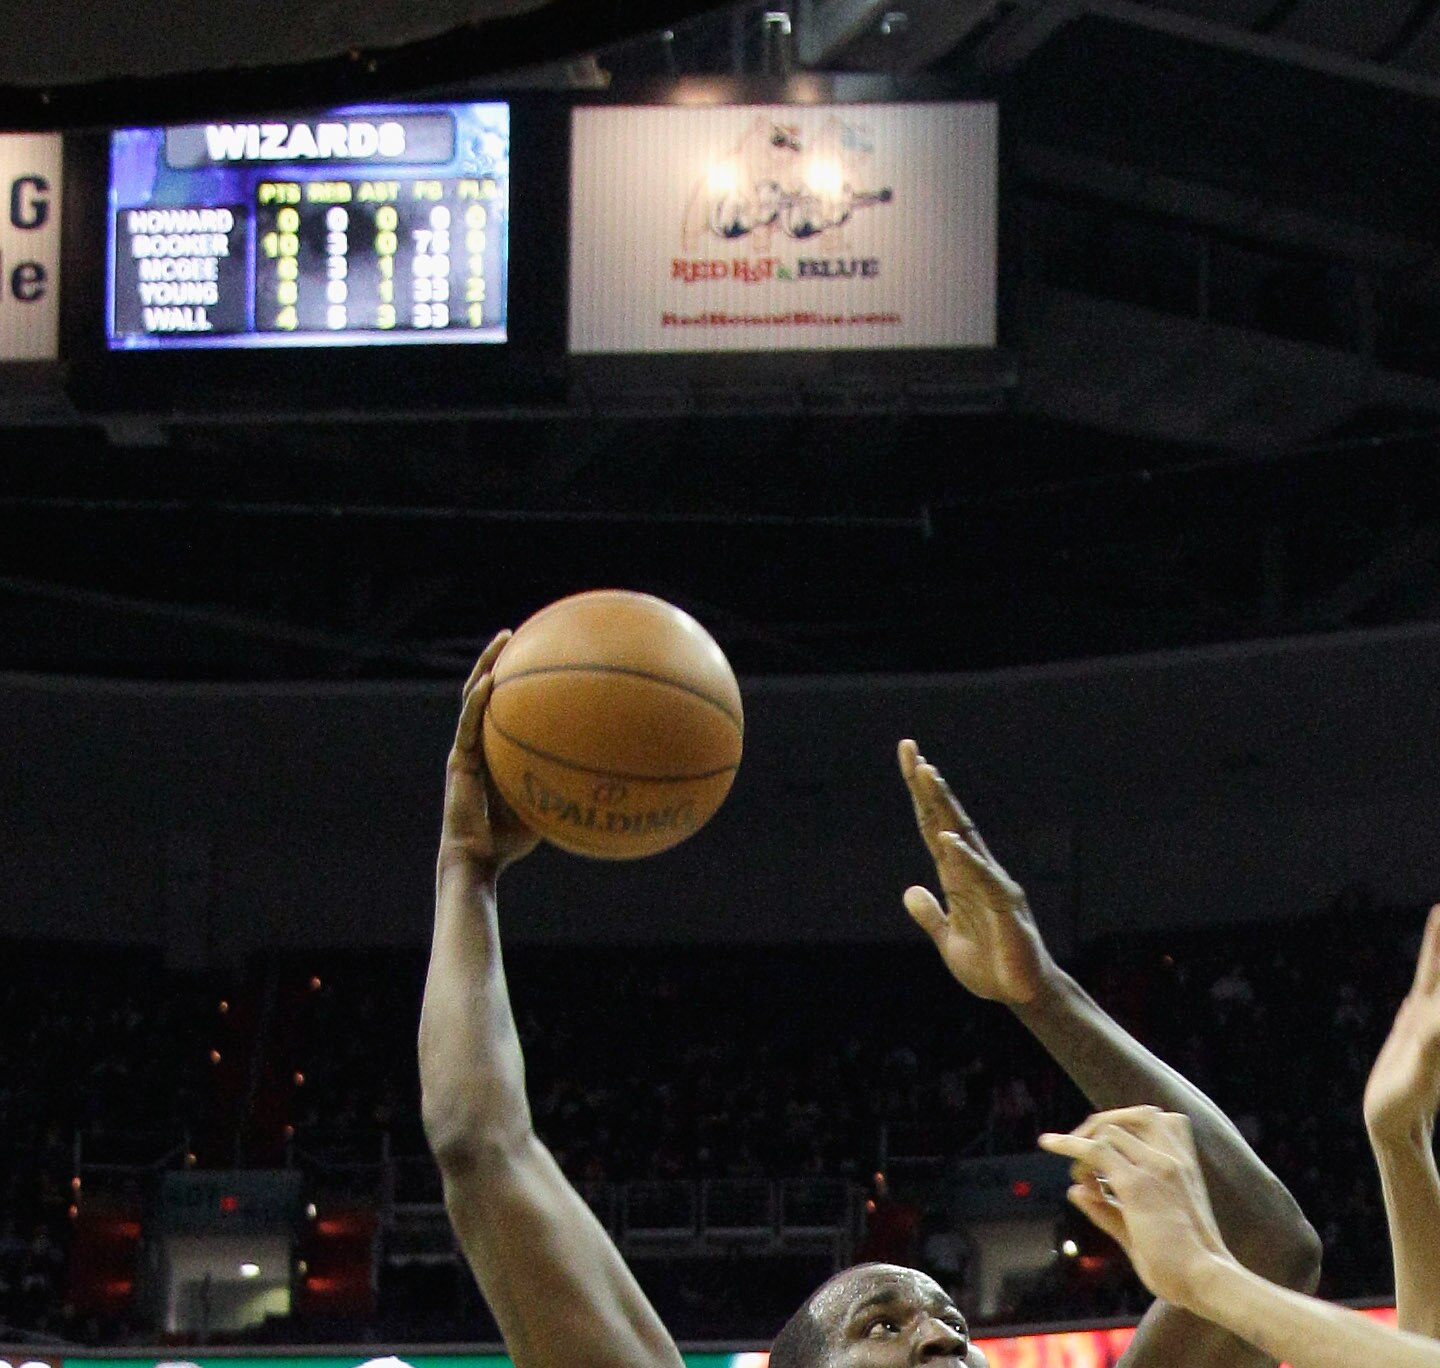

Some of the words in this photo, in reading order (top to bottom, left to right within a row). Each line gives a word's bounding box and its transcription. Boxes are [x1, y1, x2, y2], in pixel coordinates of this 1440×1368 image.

[206, 122, 406, 161] WIZARDS
[127, 208, 235, 234] HOWARD
[131, 232, 230, 259] BOOKER
[0, 260, 48, 303] e
[138, 257, 219, 282] MCGEE
[672, 257, 729, 284] RED
[798, 258, 880, 281] BLUE
[140, 281, 219, 306] YOUNG
[143, 305, 214, 332] WALL
